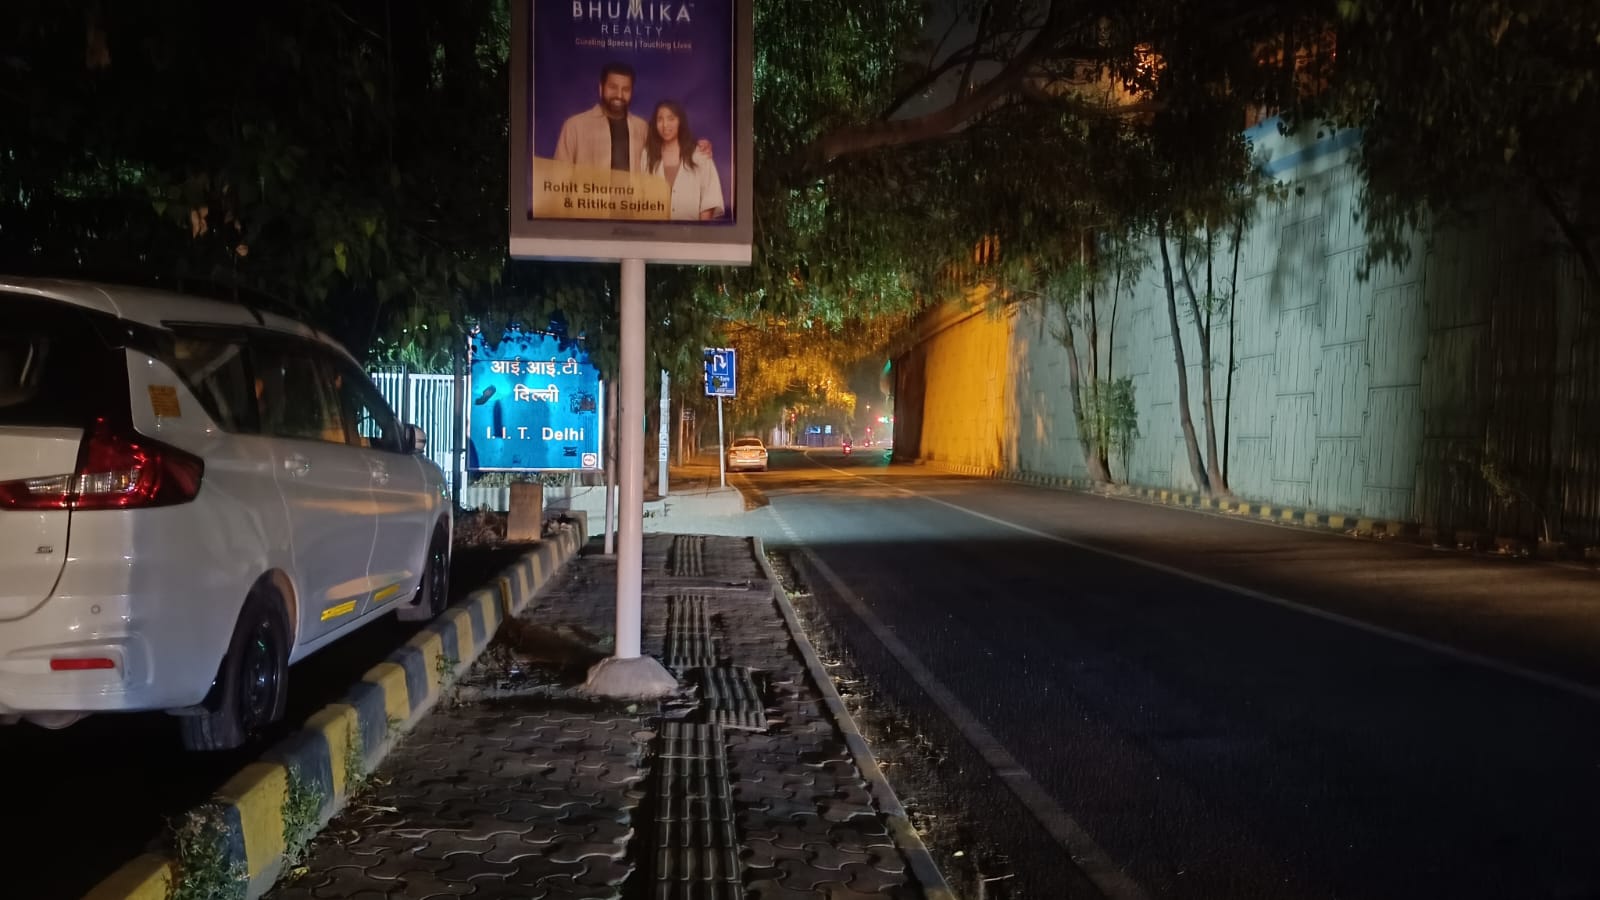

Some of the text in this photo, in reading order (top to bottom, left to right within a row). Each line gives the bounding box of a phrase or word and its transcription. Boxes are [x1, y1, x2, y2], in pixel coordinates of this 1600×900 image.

[572, 0, 691, 22] BHUMIKA
[601, 24, 663, 36] REALTY
[608, 39, 633, 48] Spaces
[640, 40, 672, 50] Touching
[673, 41, 692, 49] Lives
[544, 181, 635, 195] Rohit Sharma
[564, 198, 665, 212] & Ritika Sajdeh
[513, 383, 560, 403] दिल्ली
[517, 427, 530, 440] T.
[542, 428, 585, 441] Delhi
